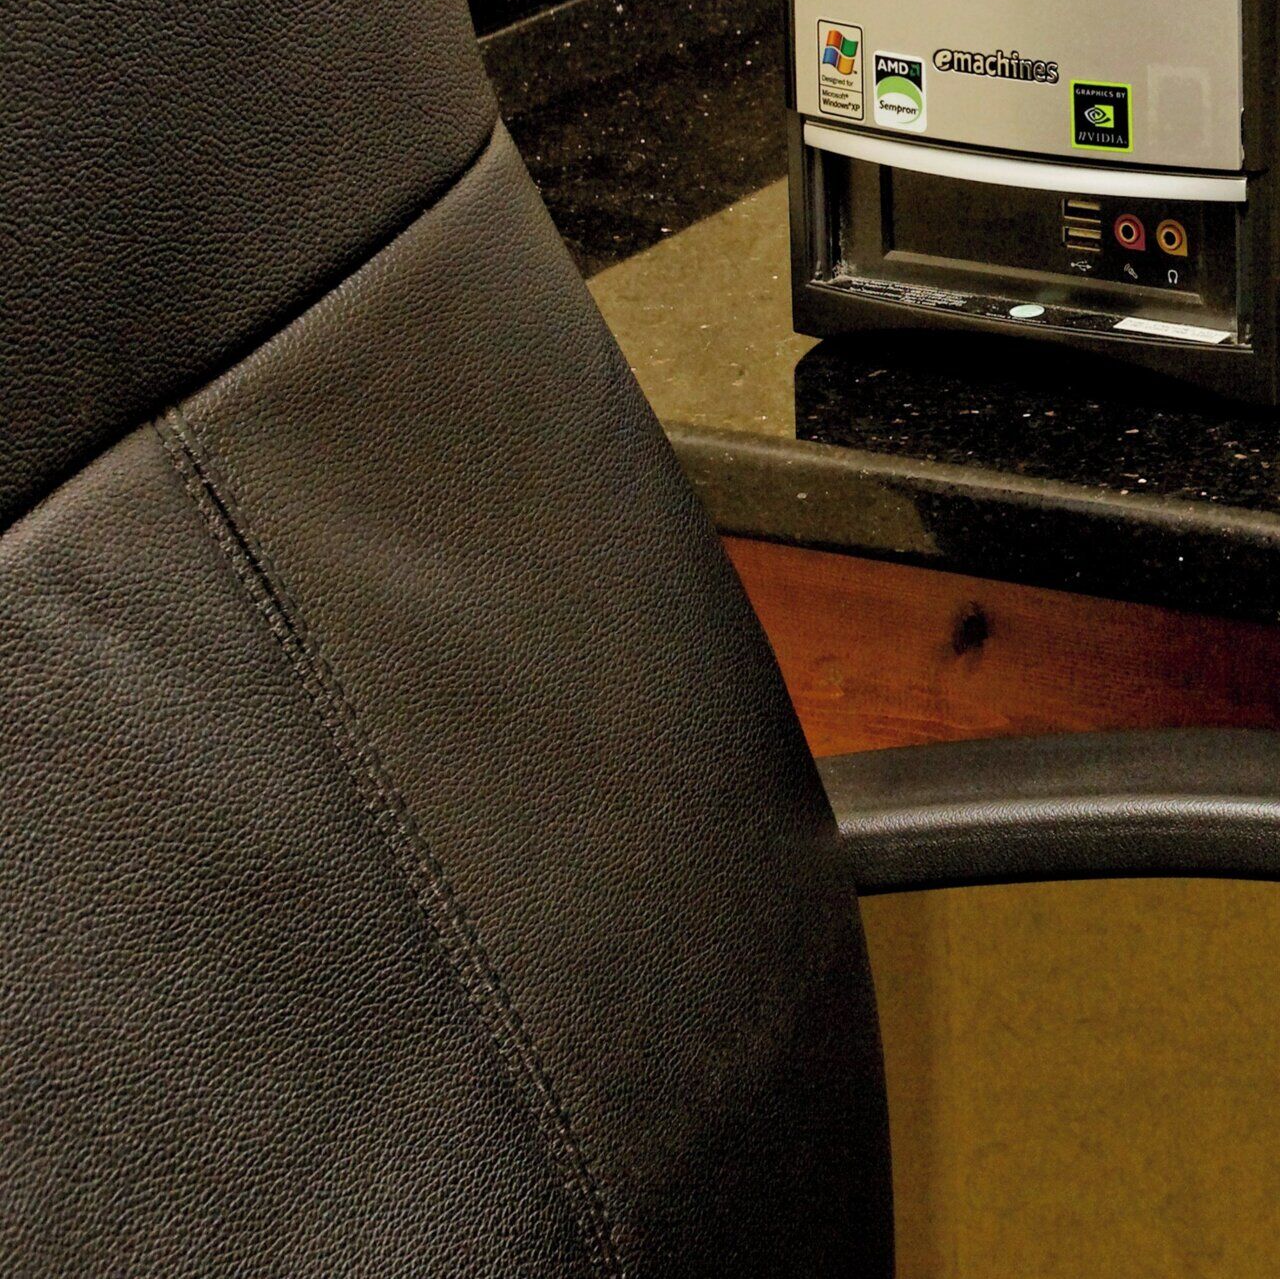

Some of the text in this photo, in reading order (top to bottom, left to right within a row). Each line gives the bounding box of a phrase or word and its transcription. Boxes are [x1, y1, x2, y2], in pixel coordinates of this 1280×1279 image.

[877, 58, 909, 75] AMD
[933, 48, 1061, 84] emachines
[1076, 88, 1126, 99] GRAPHICS BY
[851, 104, 862, 113] XP
[879, 100, 917, 115] Sempron
